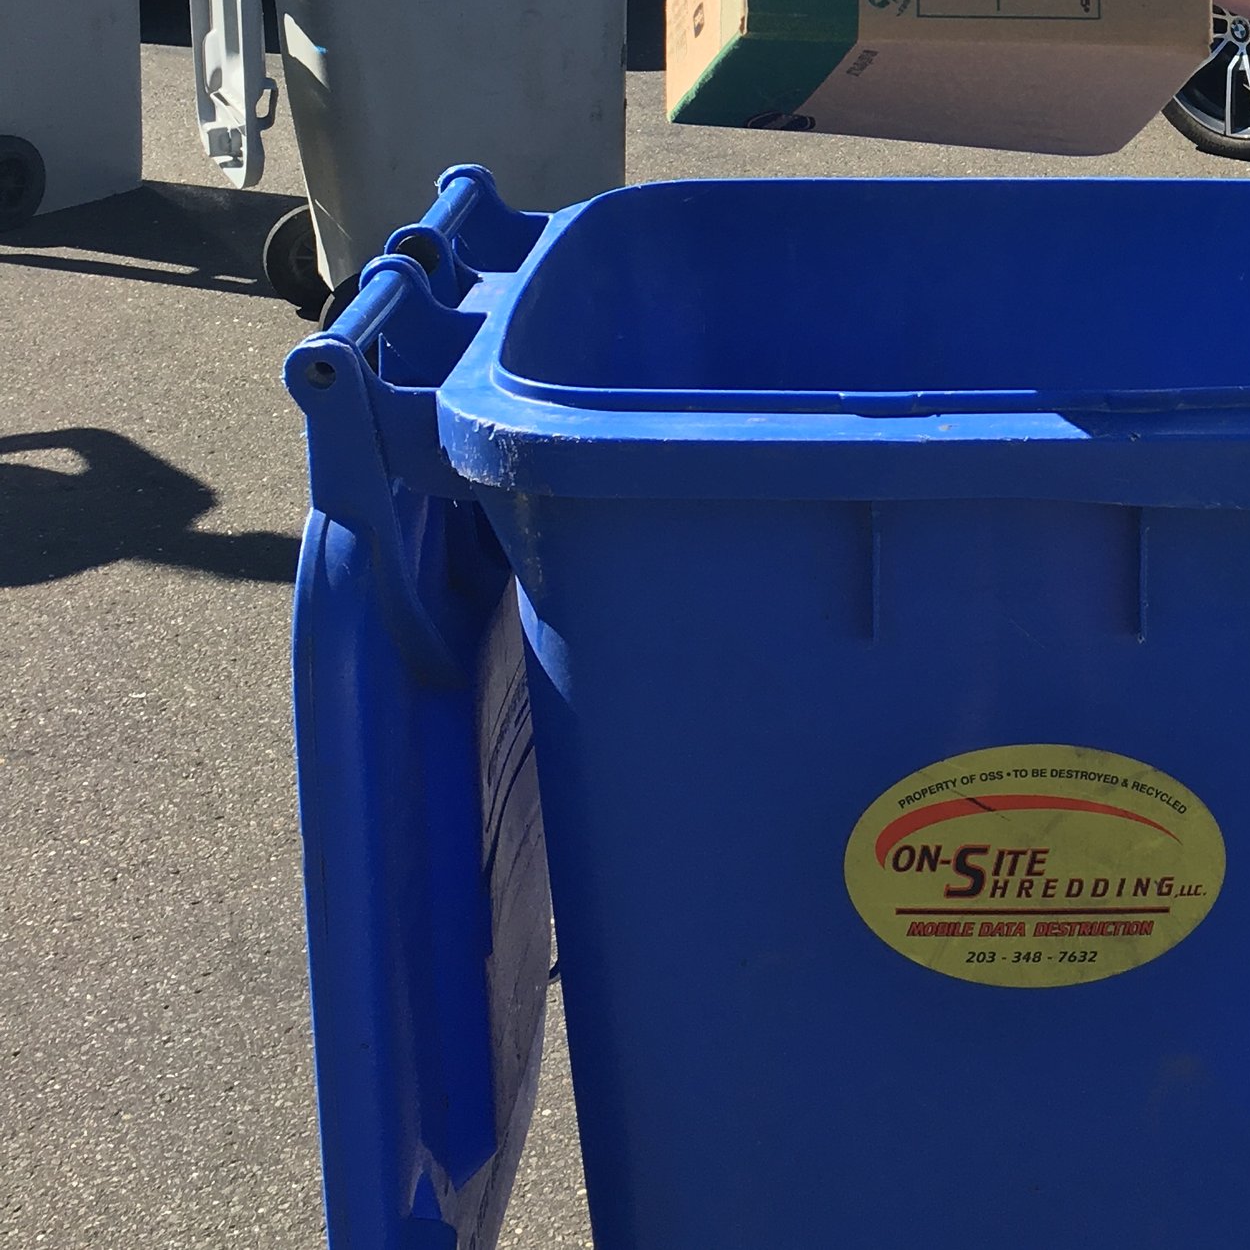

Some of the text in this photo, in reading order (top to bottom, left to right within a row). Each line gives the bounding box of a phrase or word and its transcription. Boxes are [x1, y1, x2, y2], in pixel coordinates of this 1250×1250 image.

[898, 768, 1187, 815] PROPERTY OF OSS TO BE DESTROYED & RECYCLED
[891, 844, 1050, 900] ON-SITE
[906, 920, 1154, 938] MOBILE DATA DESTRUCTION
